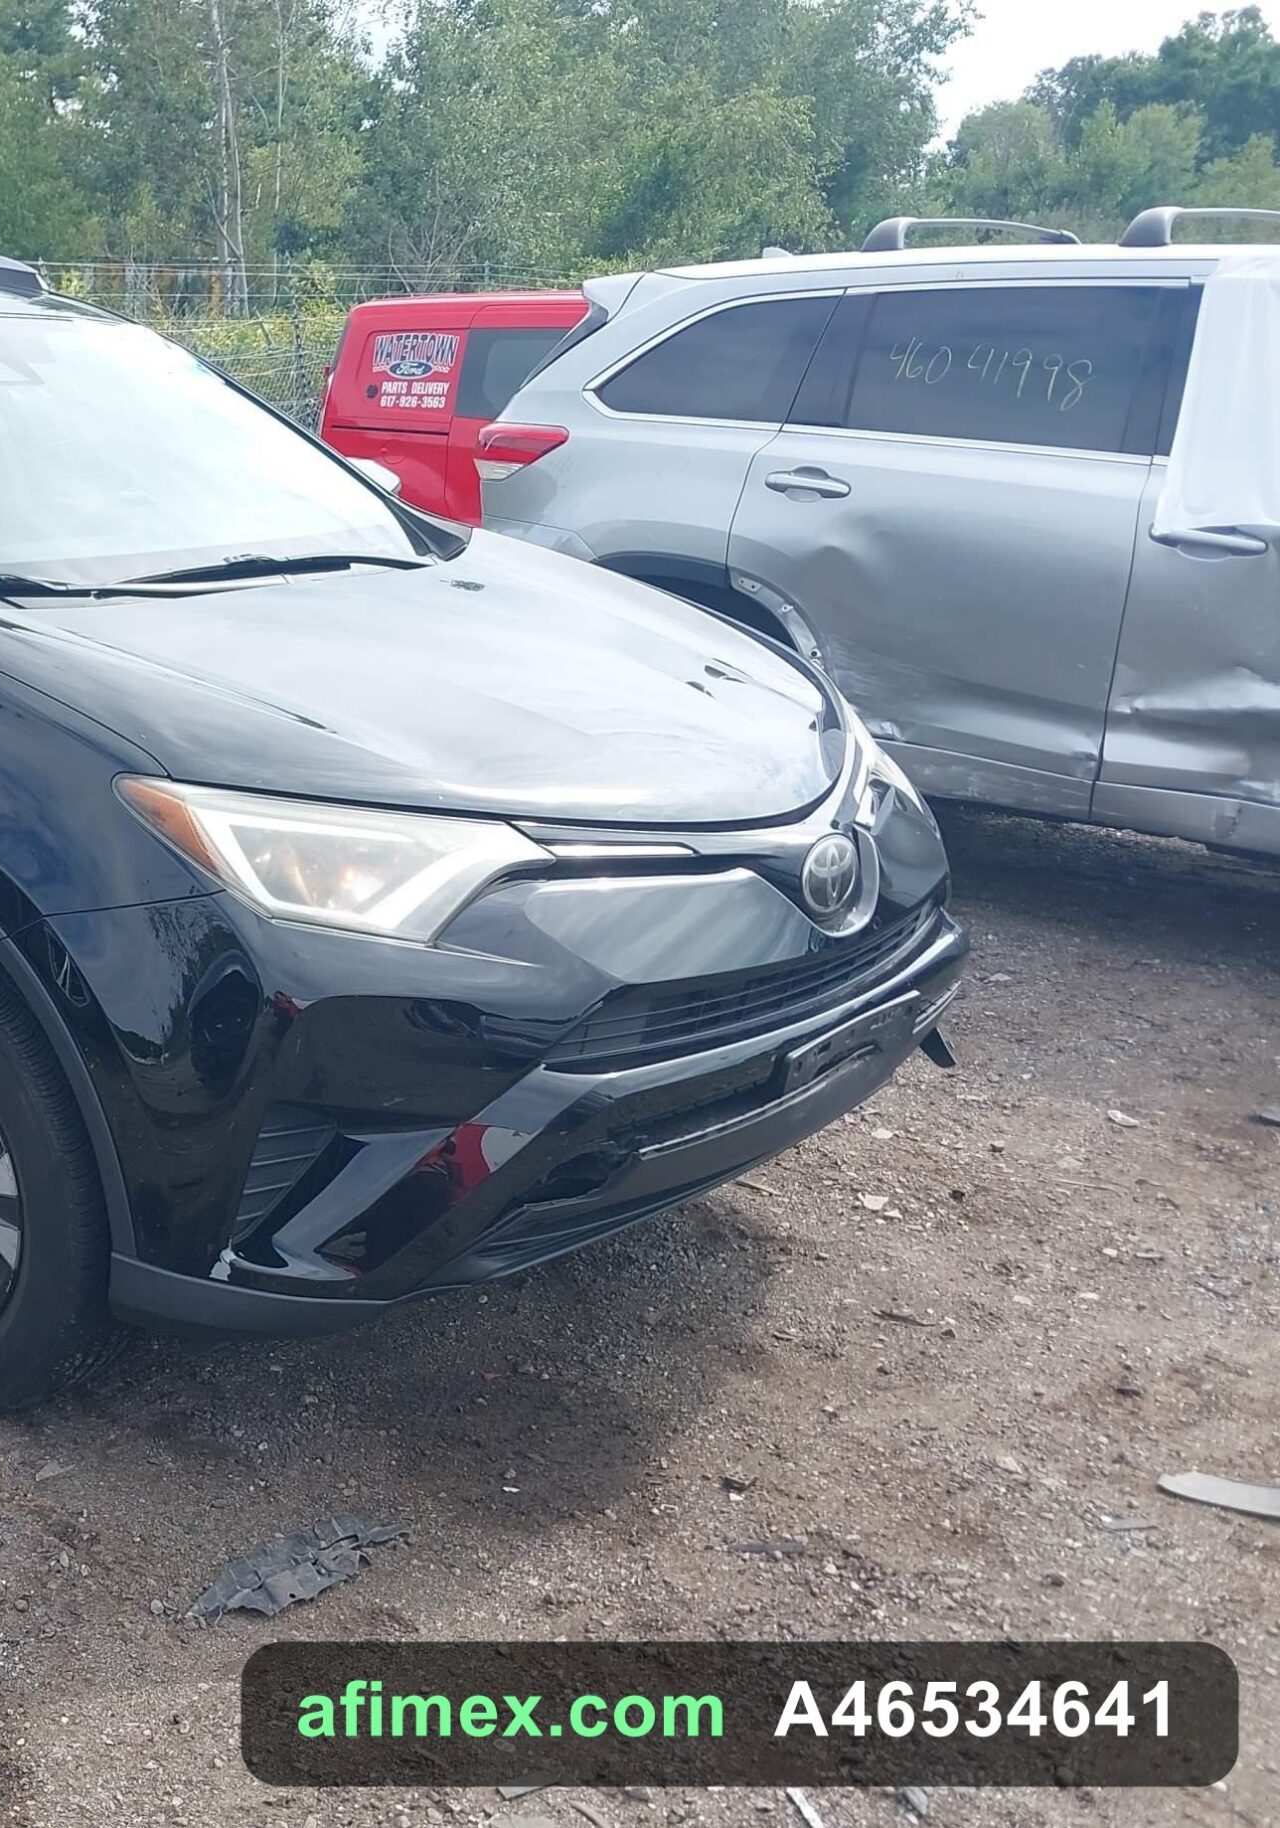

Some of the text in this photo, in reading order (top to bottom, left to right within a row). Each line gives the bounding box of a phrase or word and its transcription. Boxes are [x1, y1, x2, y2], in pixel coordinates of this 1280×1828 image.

[372, 333, 460, 367] WATERTOWN
[395, 362, 425, 375] Ford
[889, 336, 1097, 412] 460 41998
[381, 381, 450, 395] PARTS DELIVERY
[380, 395, 446, 408] 617-926-3563
